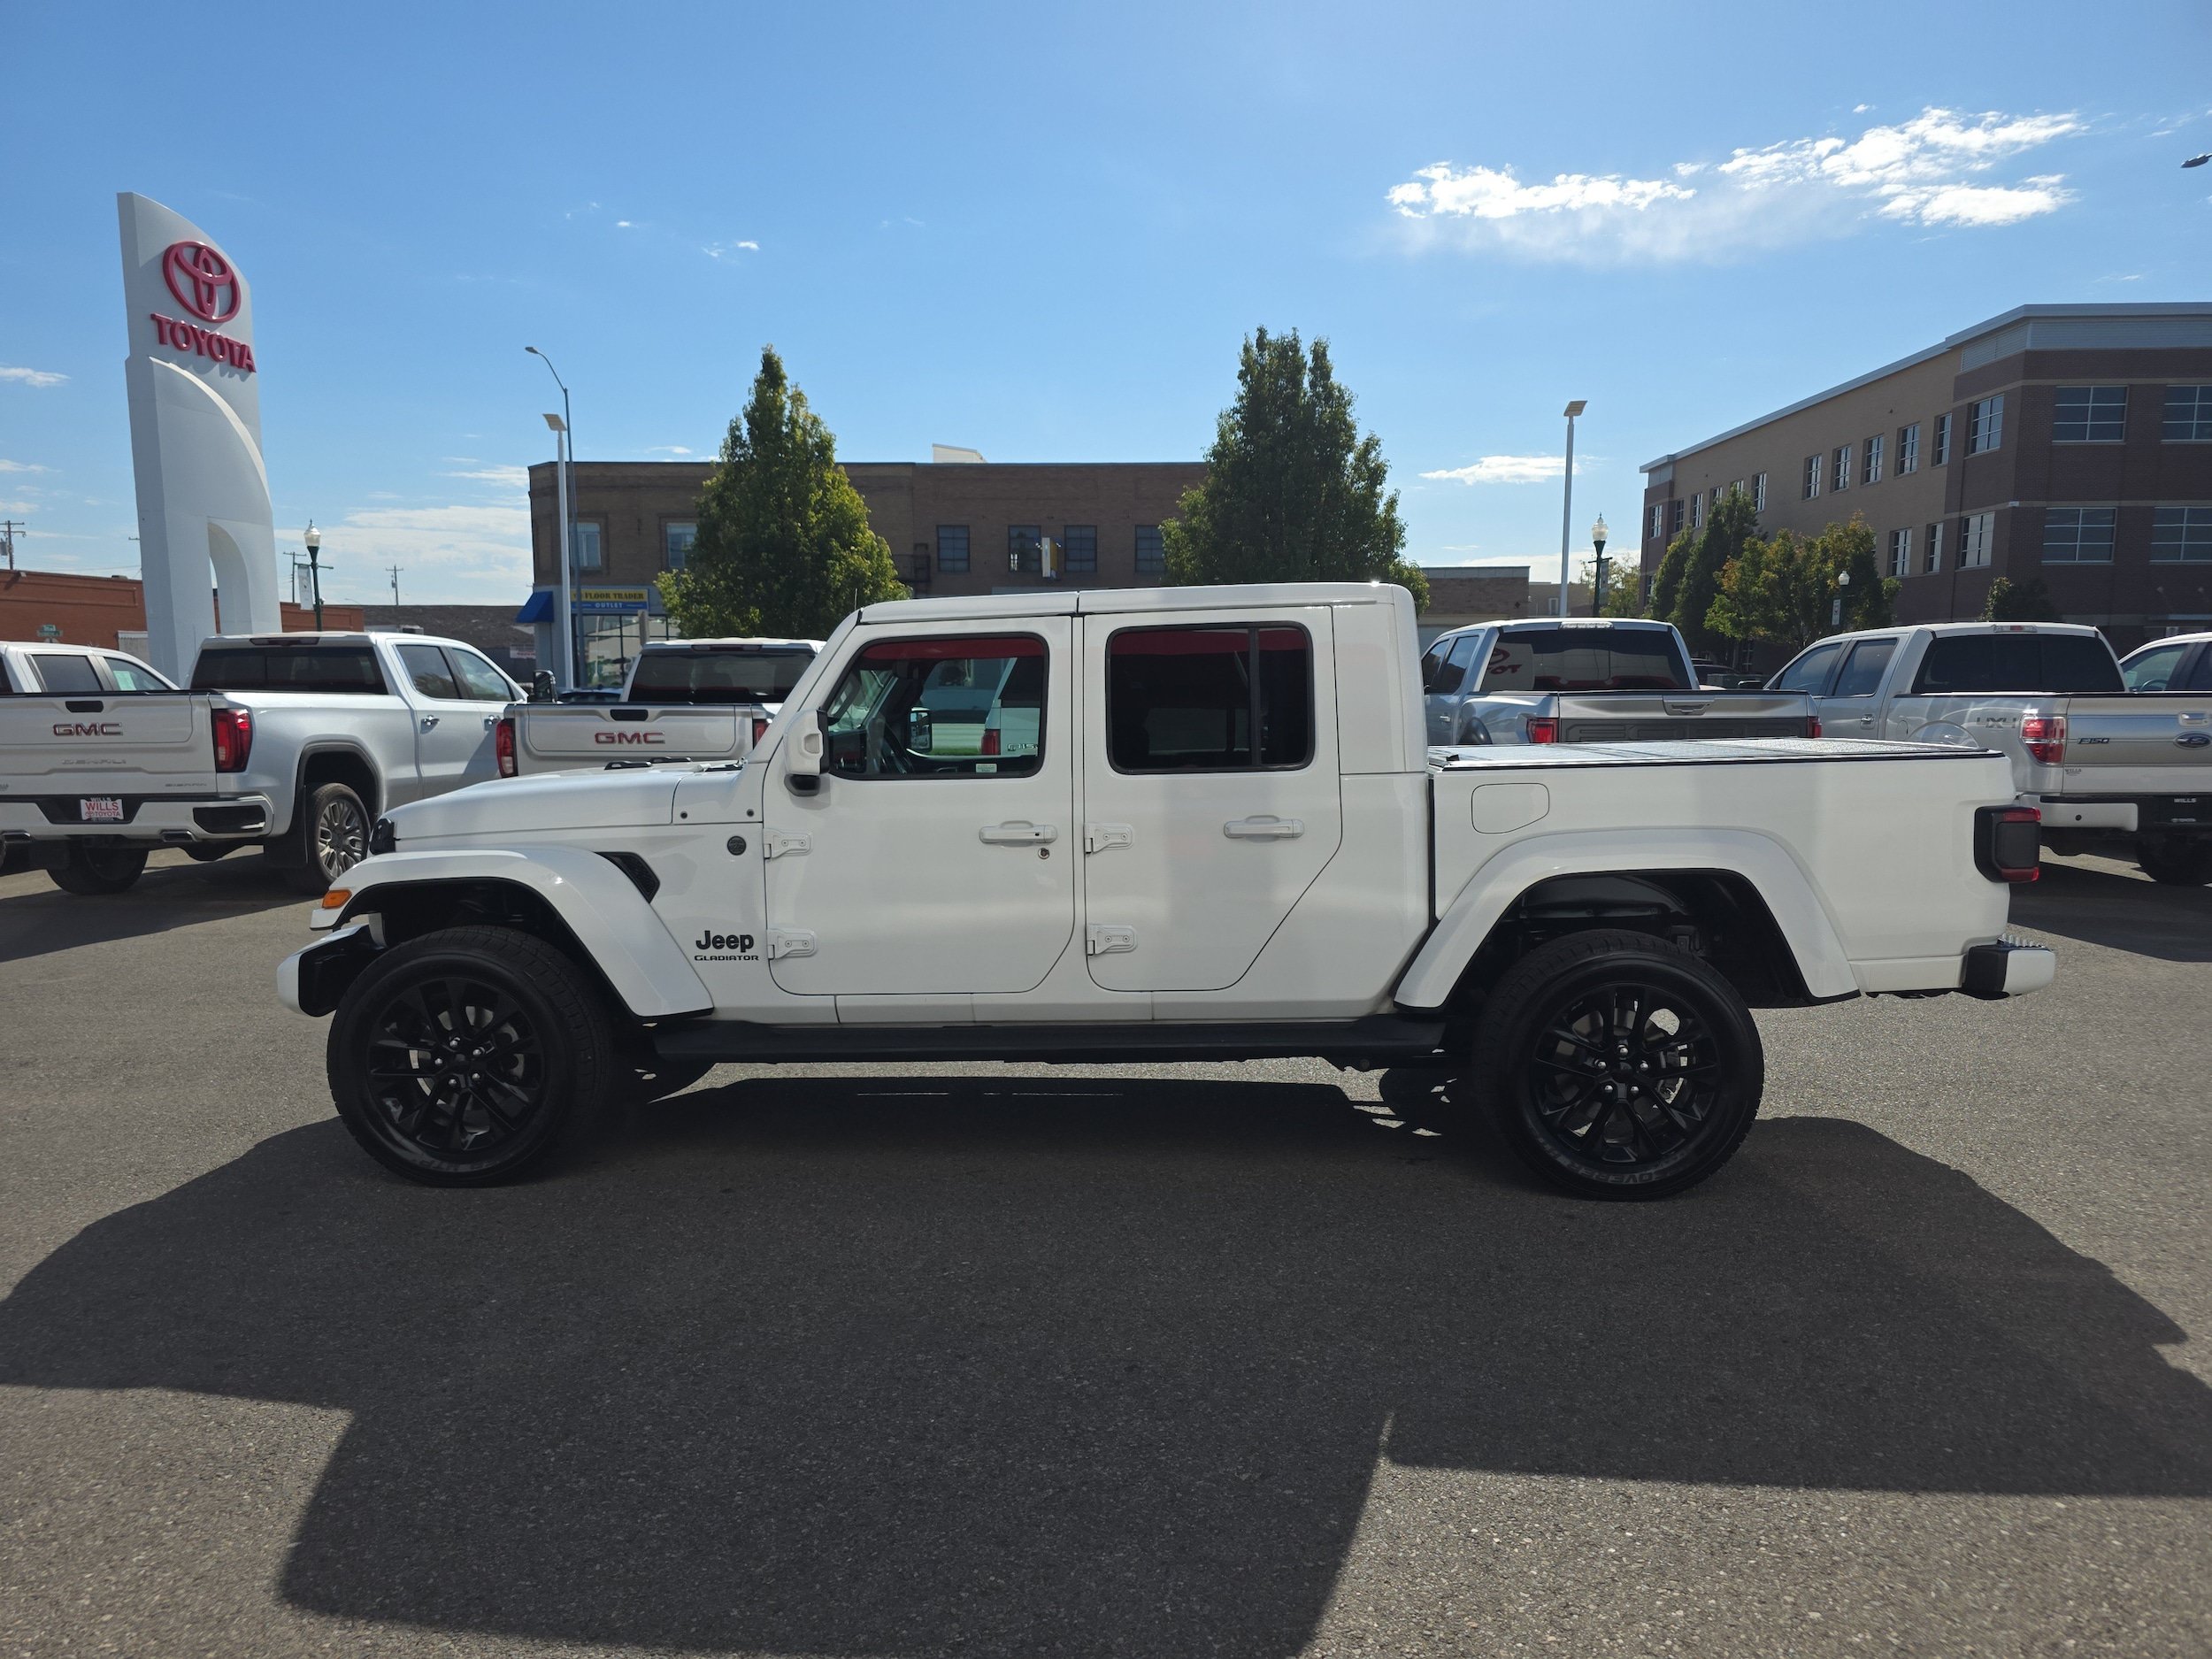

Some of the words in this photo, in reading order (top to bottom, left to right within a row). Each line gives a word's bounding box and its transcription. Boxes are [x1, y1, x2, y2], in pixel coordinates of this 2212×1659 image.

[150, 313, 257, 373] TOYOTA
[53, 722, 123, 736] GMC
[595, 732, 665, 744] GMC
[85, 802, 119, 811] WILLS
[695, 930, 755, 953] Jeep
